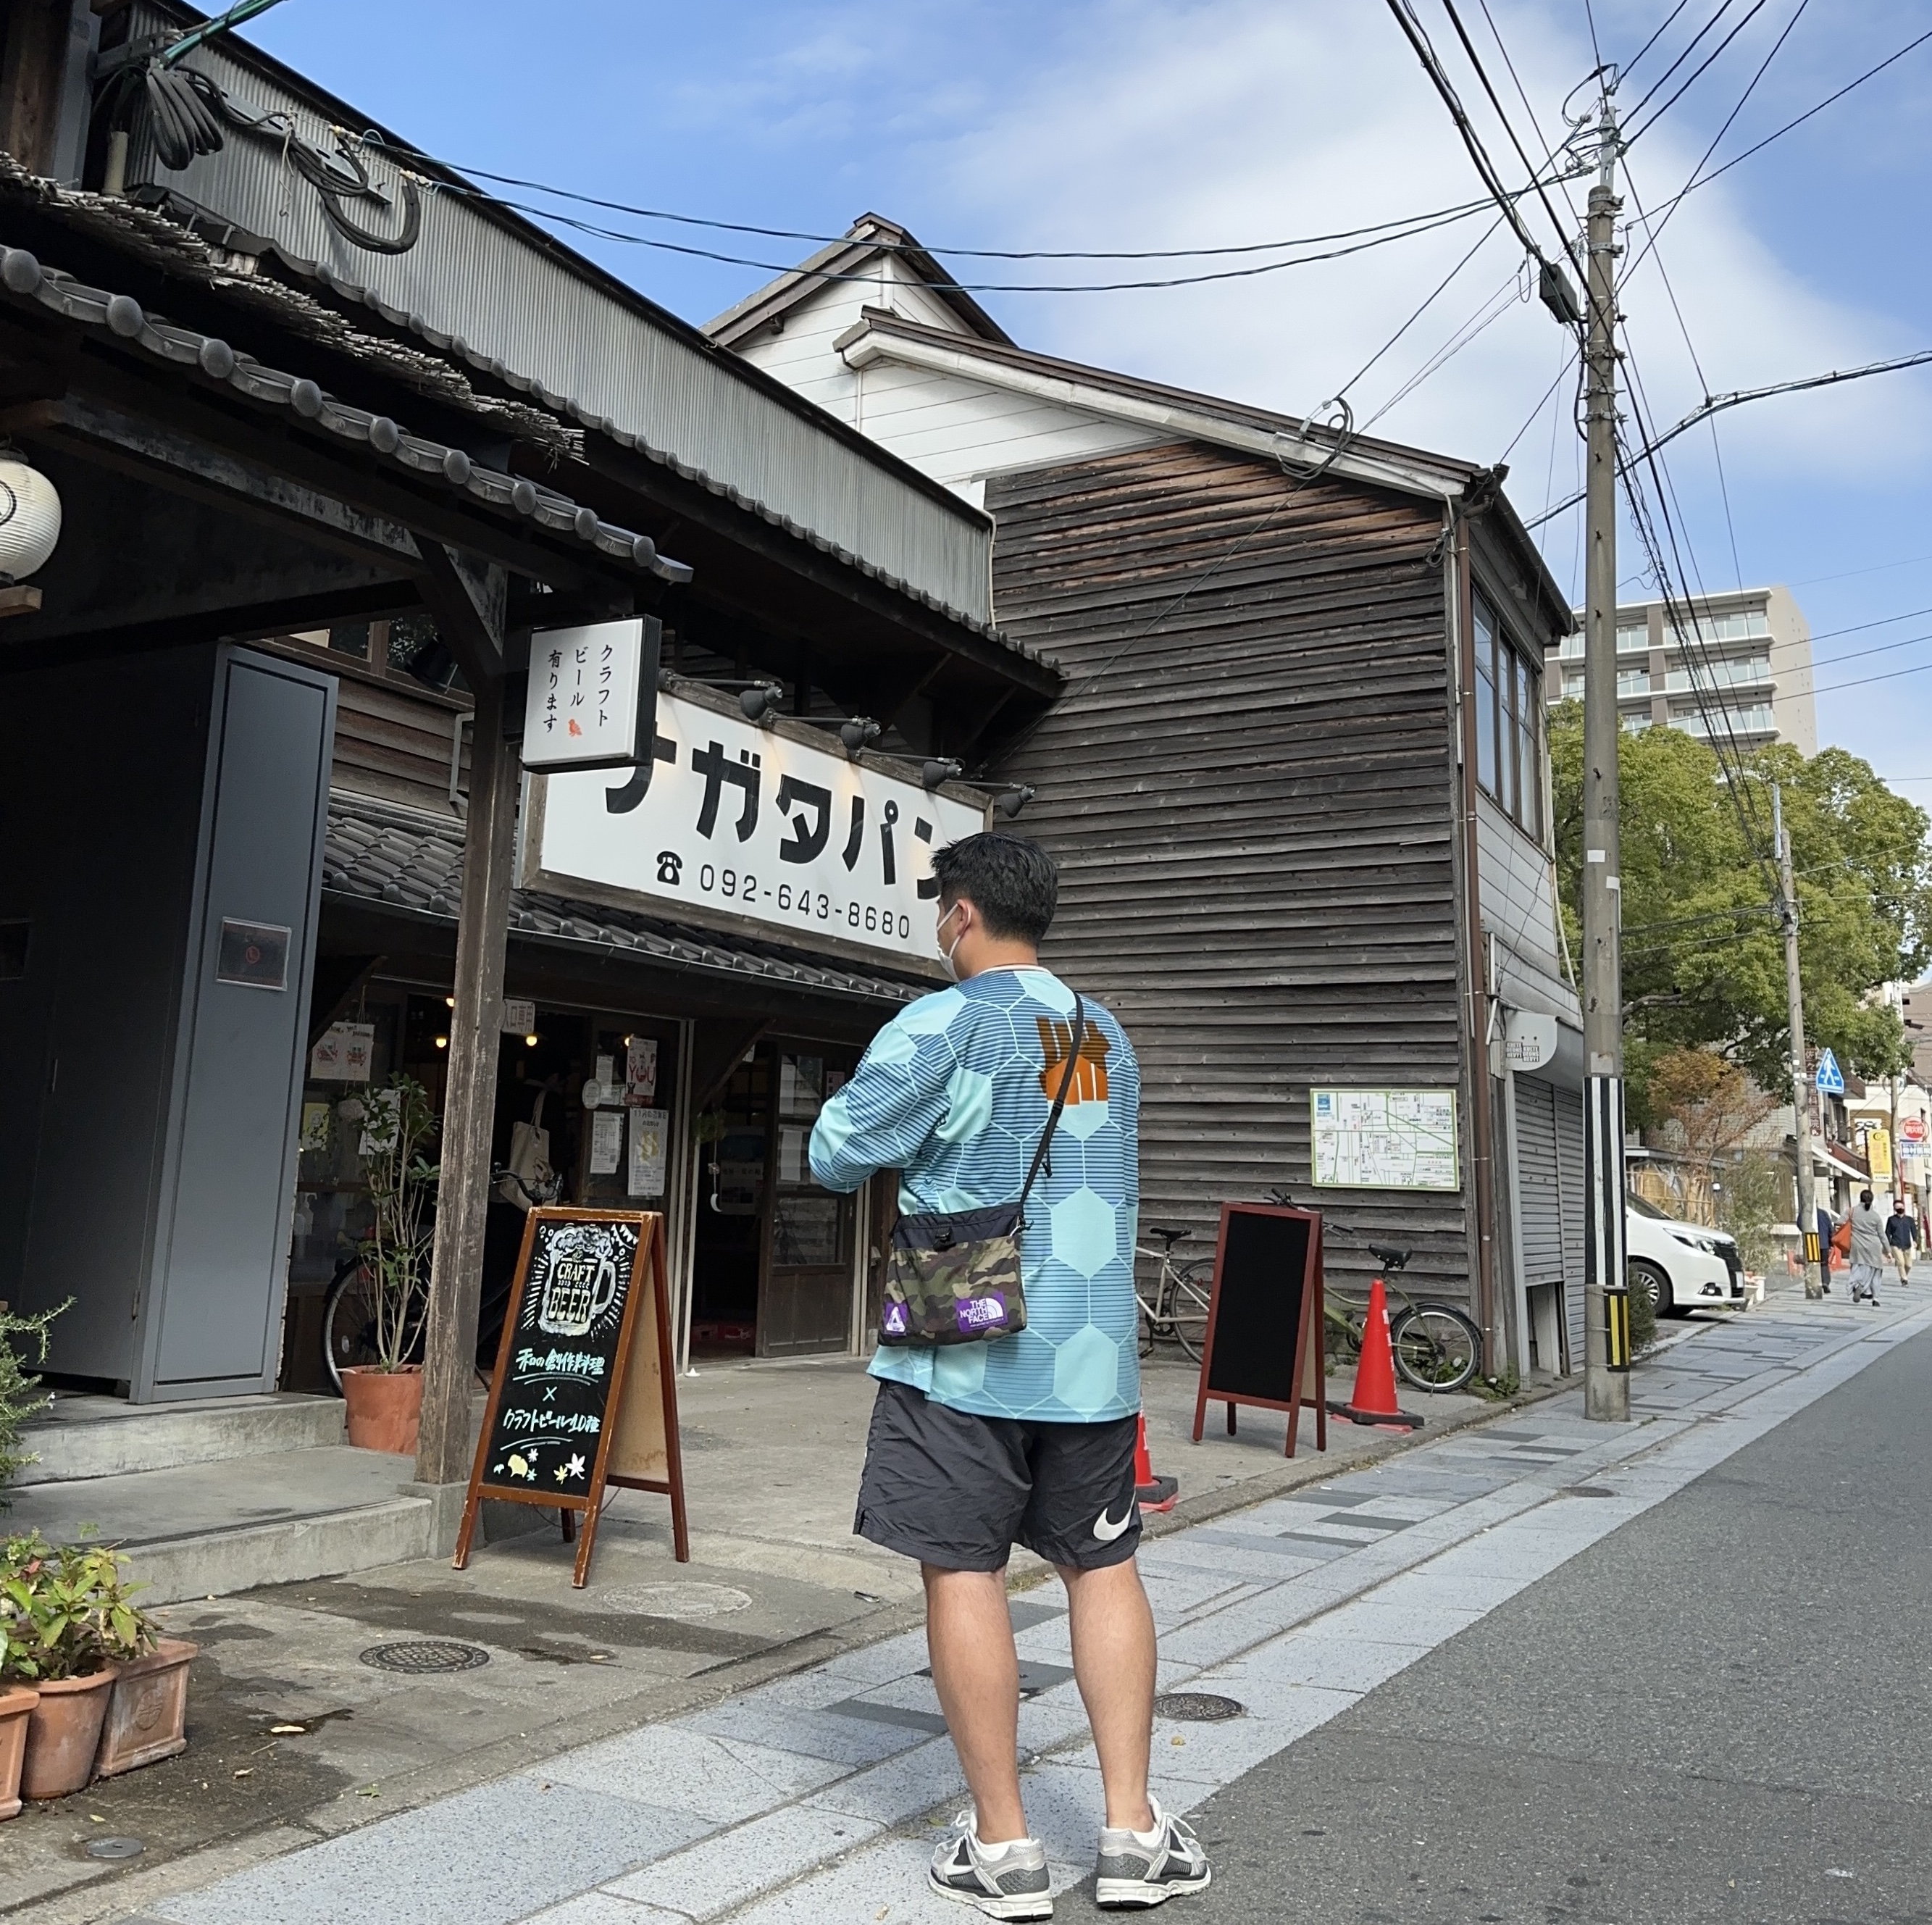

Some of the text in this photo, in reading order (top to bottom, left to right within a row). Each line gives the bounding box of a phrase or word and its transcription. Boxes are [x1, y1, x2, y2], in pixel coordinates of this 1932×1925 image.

[569, 646, 589, 707] ビール
[598, 644, 613, 727] クラフト
[543, 649, 564, 733] 有ります
[699, 862, 911, 940] 092-643-8680
[557, 1263, 595, 1282] CRAFT
[548, 1287, 591, 1323] BEER
[959, 1306, 988, 1319] NORTH
[969, 1298, 987, 1309] THE
[968, 1313, 989, 1324] FACE
[515, 1348, 606, 1376] 和の創作料理
[502, 1408, 601, 1434] クラフトビール10種
